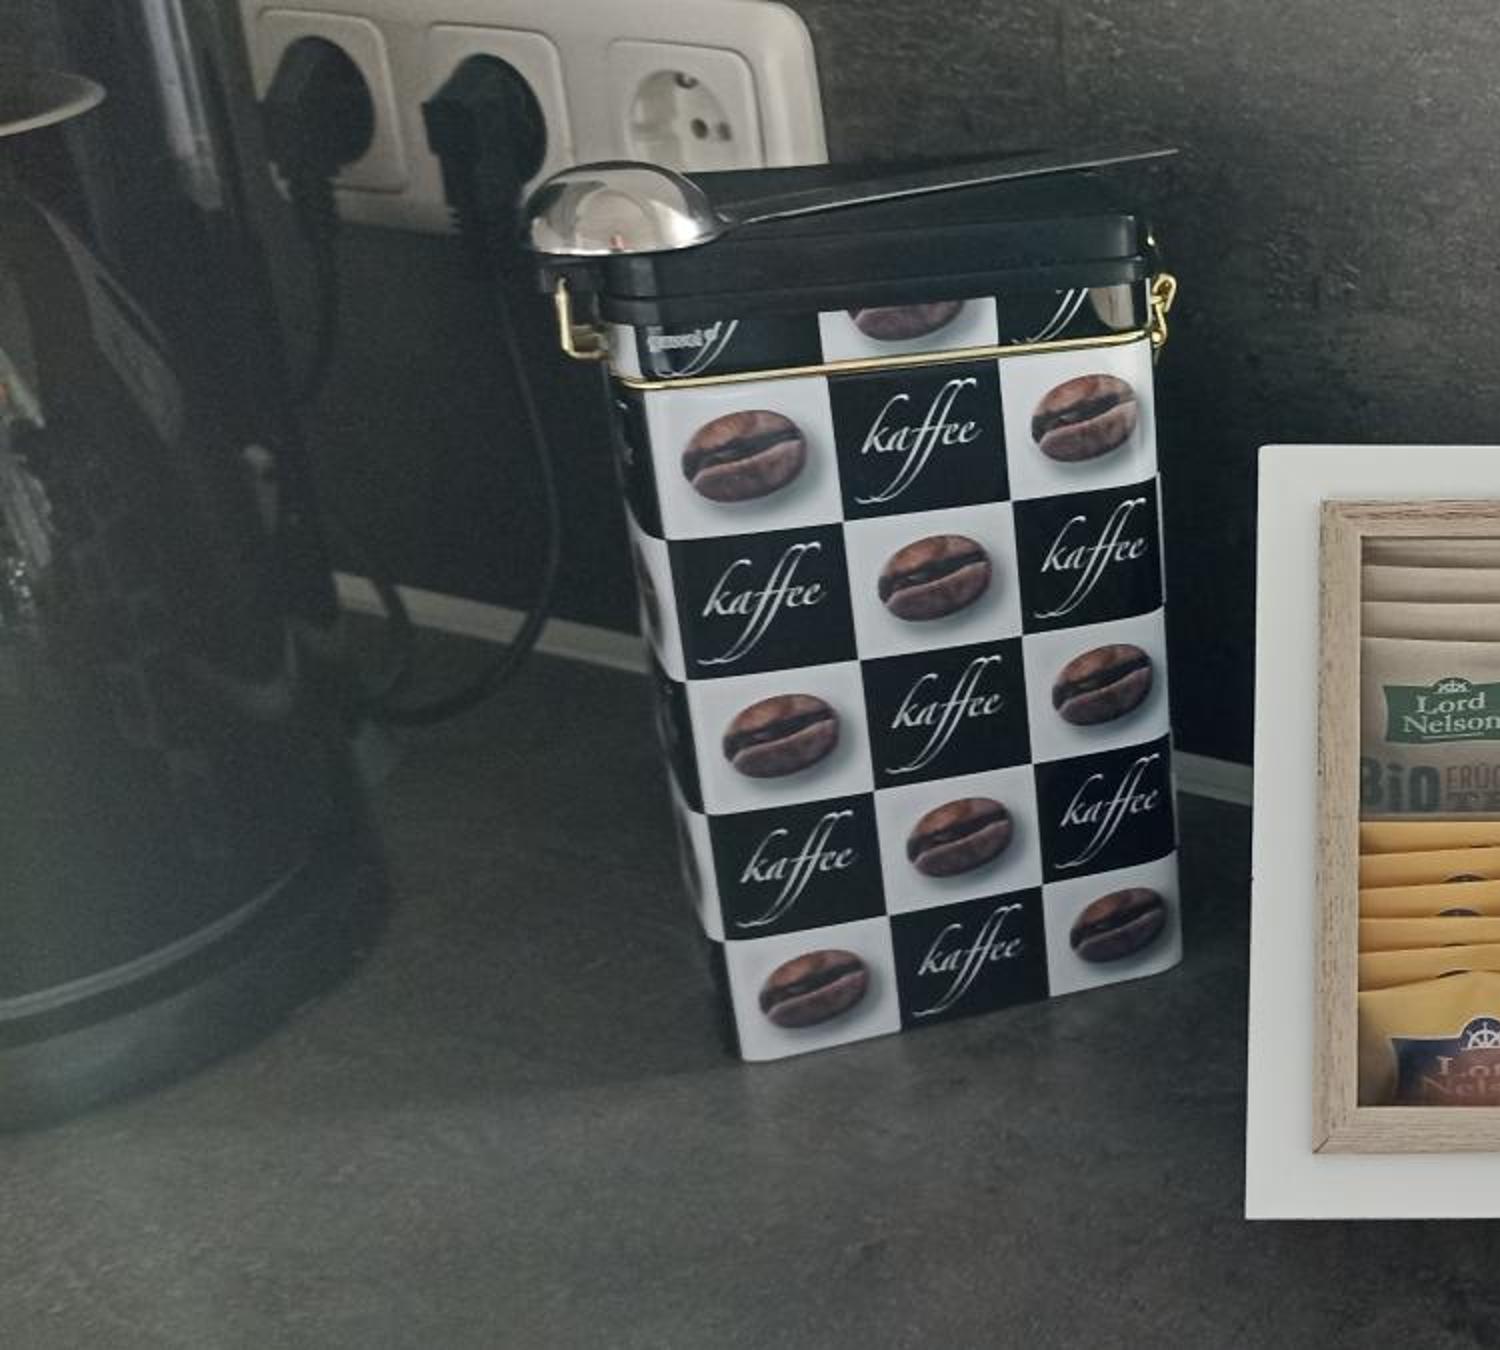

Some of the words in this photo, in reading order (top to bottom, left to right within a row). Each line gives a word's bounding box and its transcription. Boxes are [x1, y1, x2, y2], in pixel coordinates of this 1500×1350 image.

[855, 377, 982, 505] kaffee
[697, 541, 828, 665] kaffee
[1034, 497, 1148, 620] kaffee
[886, 655, 1003, 776] kaffee
[1415, 691, 1487, 716] Lord
[737, 811, 855, 928] kaffee
[1054, 753, 1162, 871] kaffee
[912, 904, 1024, 1018] kaffee
